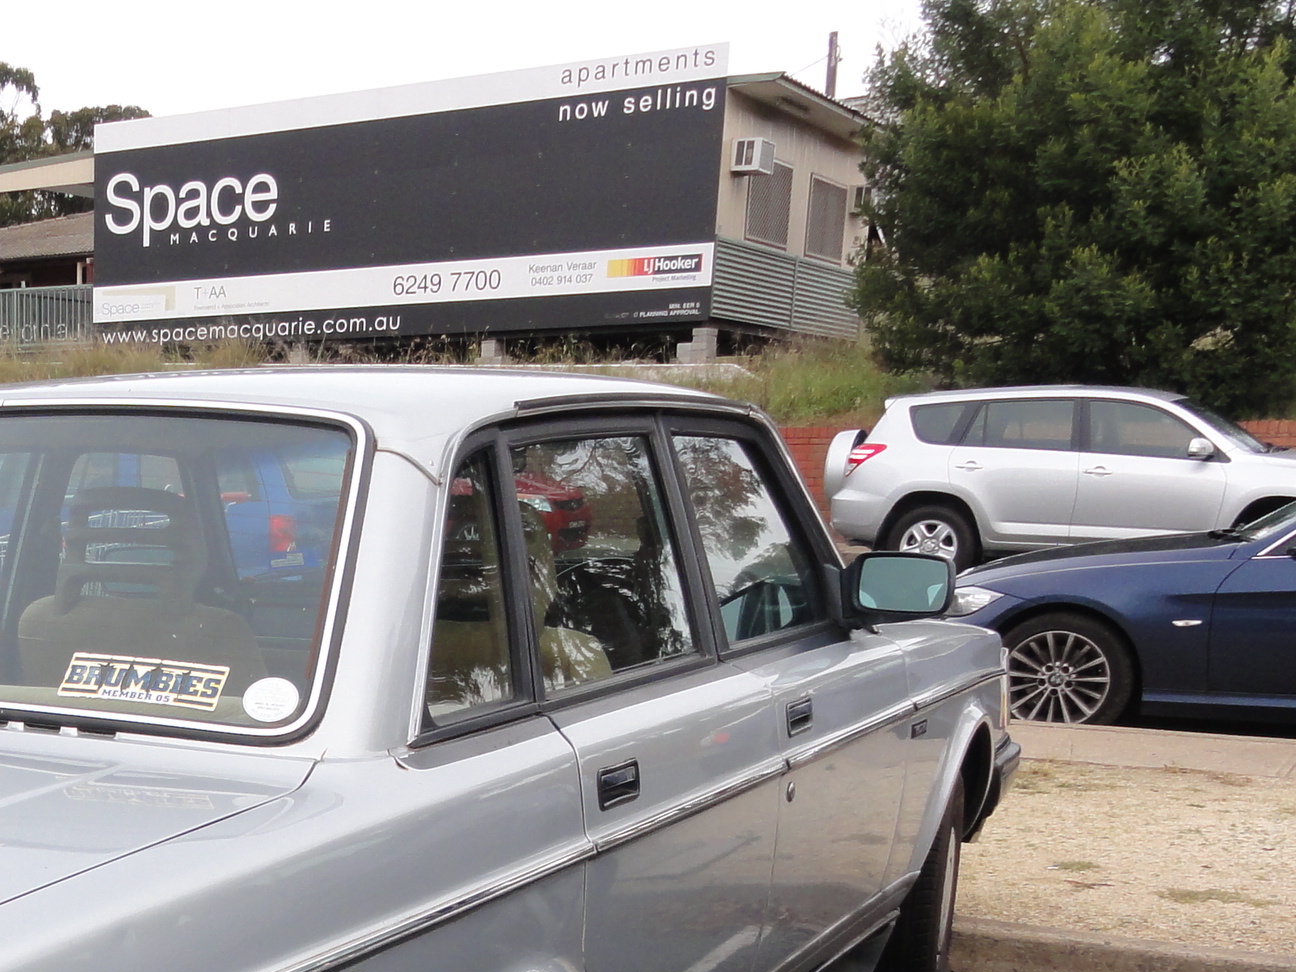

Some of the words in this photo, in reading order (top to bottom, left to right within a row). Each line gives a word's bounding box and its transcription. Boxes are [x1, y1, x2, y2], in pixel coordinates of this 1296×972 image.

[560, 48, 716, 88] apartments
[558, 99, 609, 122] now
[622, 86, 716, 114] selling
[104, 172, 278, 248] Space
[170, 219, 331, 245] MACQUARIE
[528, 262, 564, 274] Keenan
[530, 276, 554, 287] 0402
[556, 274, 573, 285] 914
[575, 273, 593, 284] 037
[393, 272, 442, 296] 6249
[450, 269, 501, 292] 7700
[101, 302, 140, 318] Space
[102, 314, 402, 346] www.spacemacquarie.com.au
[65, 663, 222, 699] BRUMBIES
[101, 689, 152, 701] MEMBER
